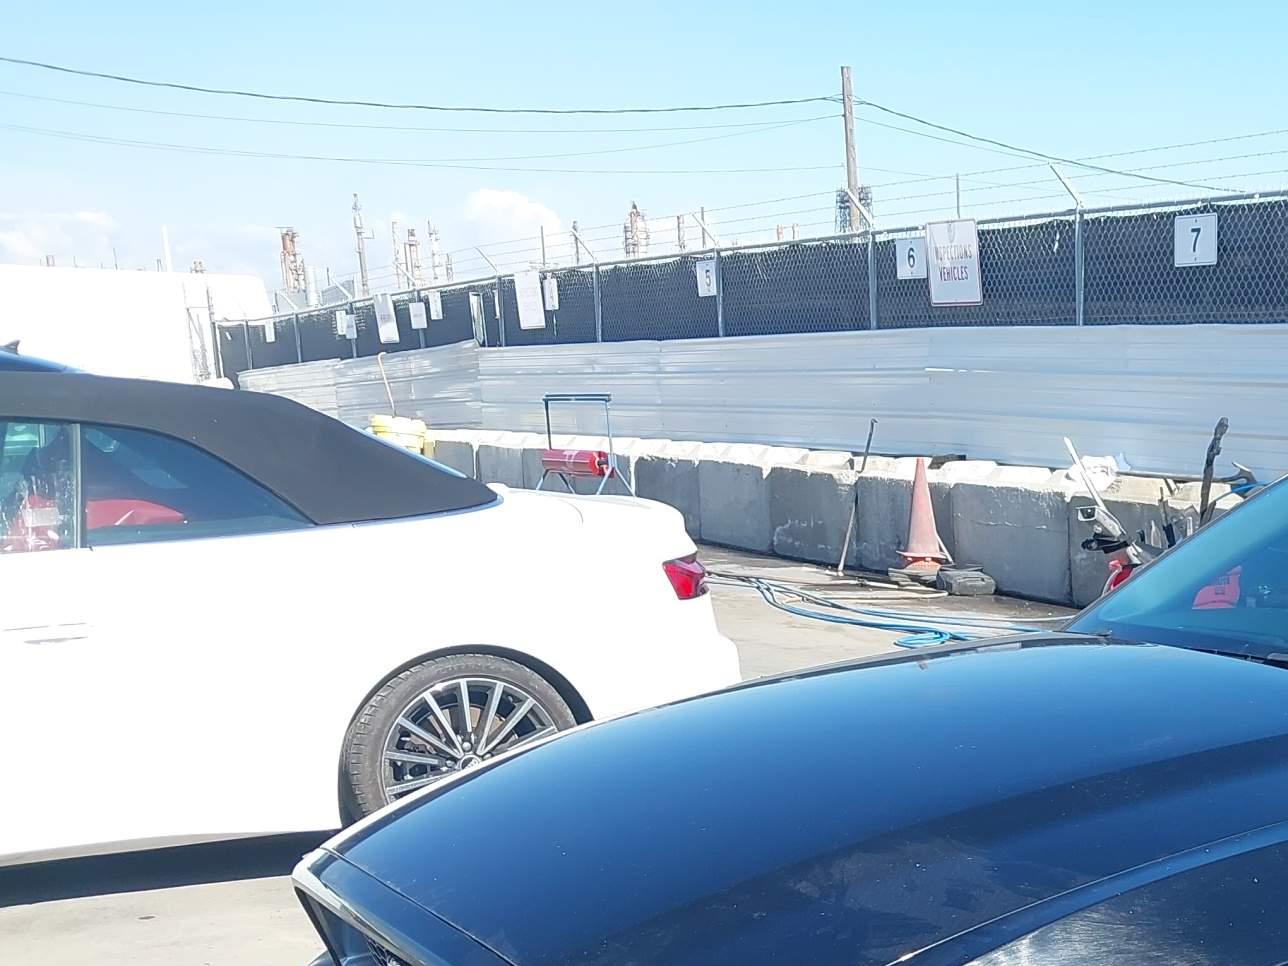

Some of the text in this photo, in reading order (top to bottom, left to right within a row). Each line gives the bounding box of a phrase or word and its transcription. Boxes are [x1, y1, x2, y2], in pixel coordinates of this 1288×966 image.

[1190, 228, 1202, 253] 7
[907, 247, 916, 268] 6
[705, 269, 712, 288] 5
[939, 265, 969, 282] VEHICLES
